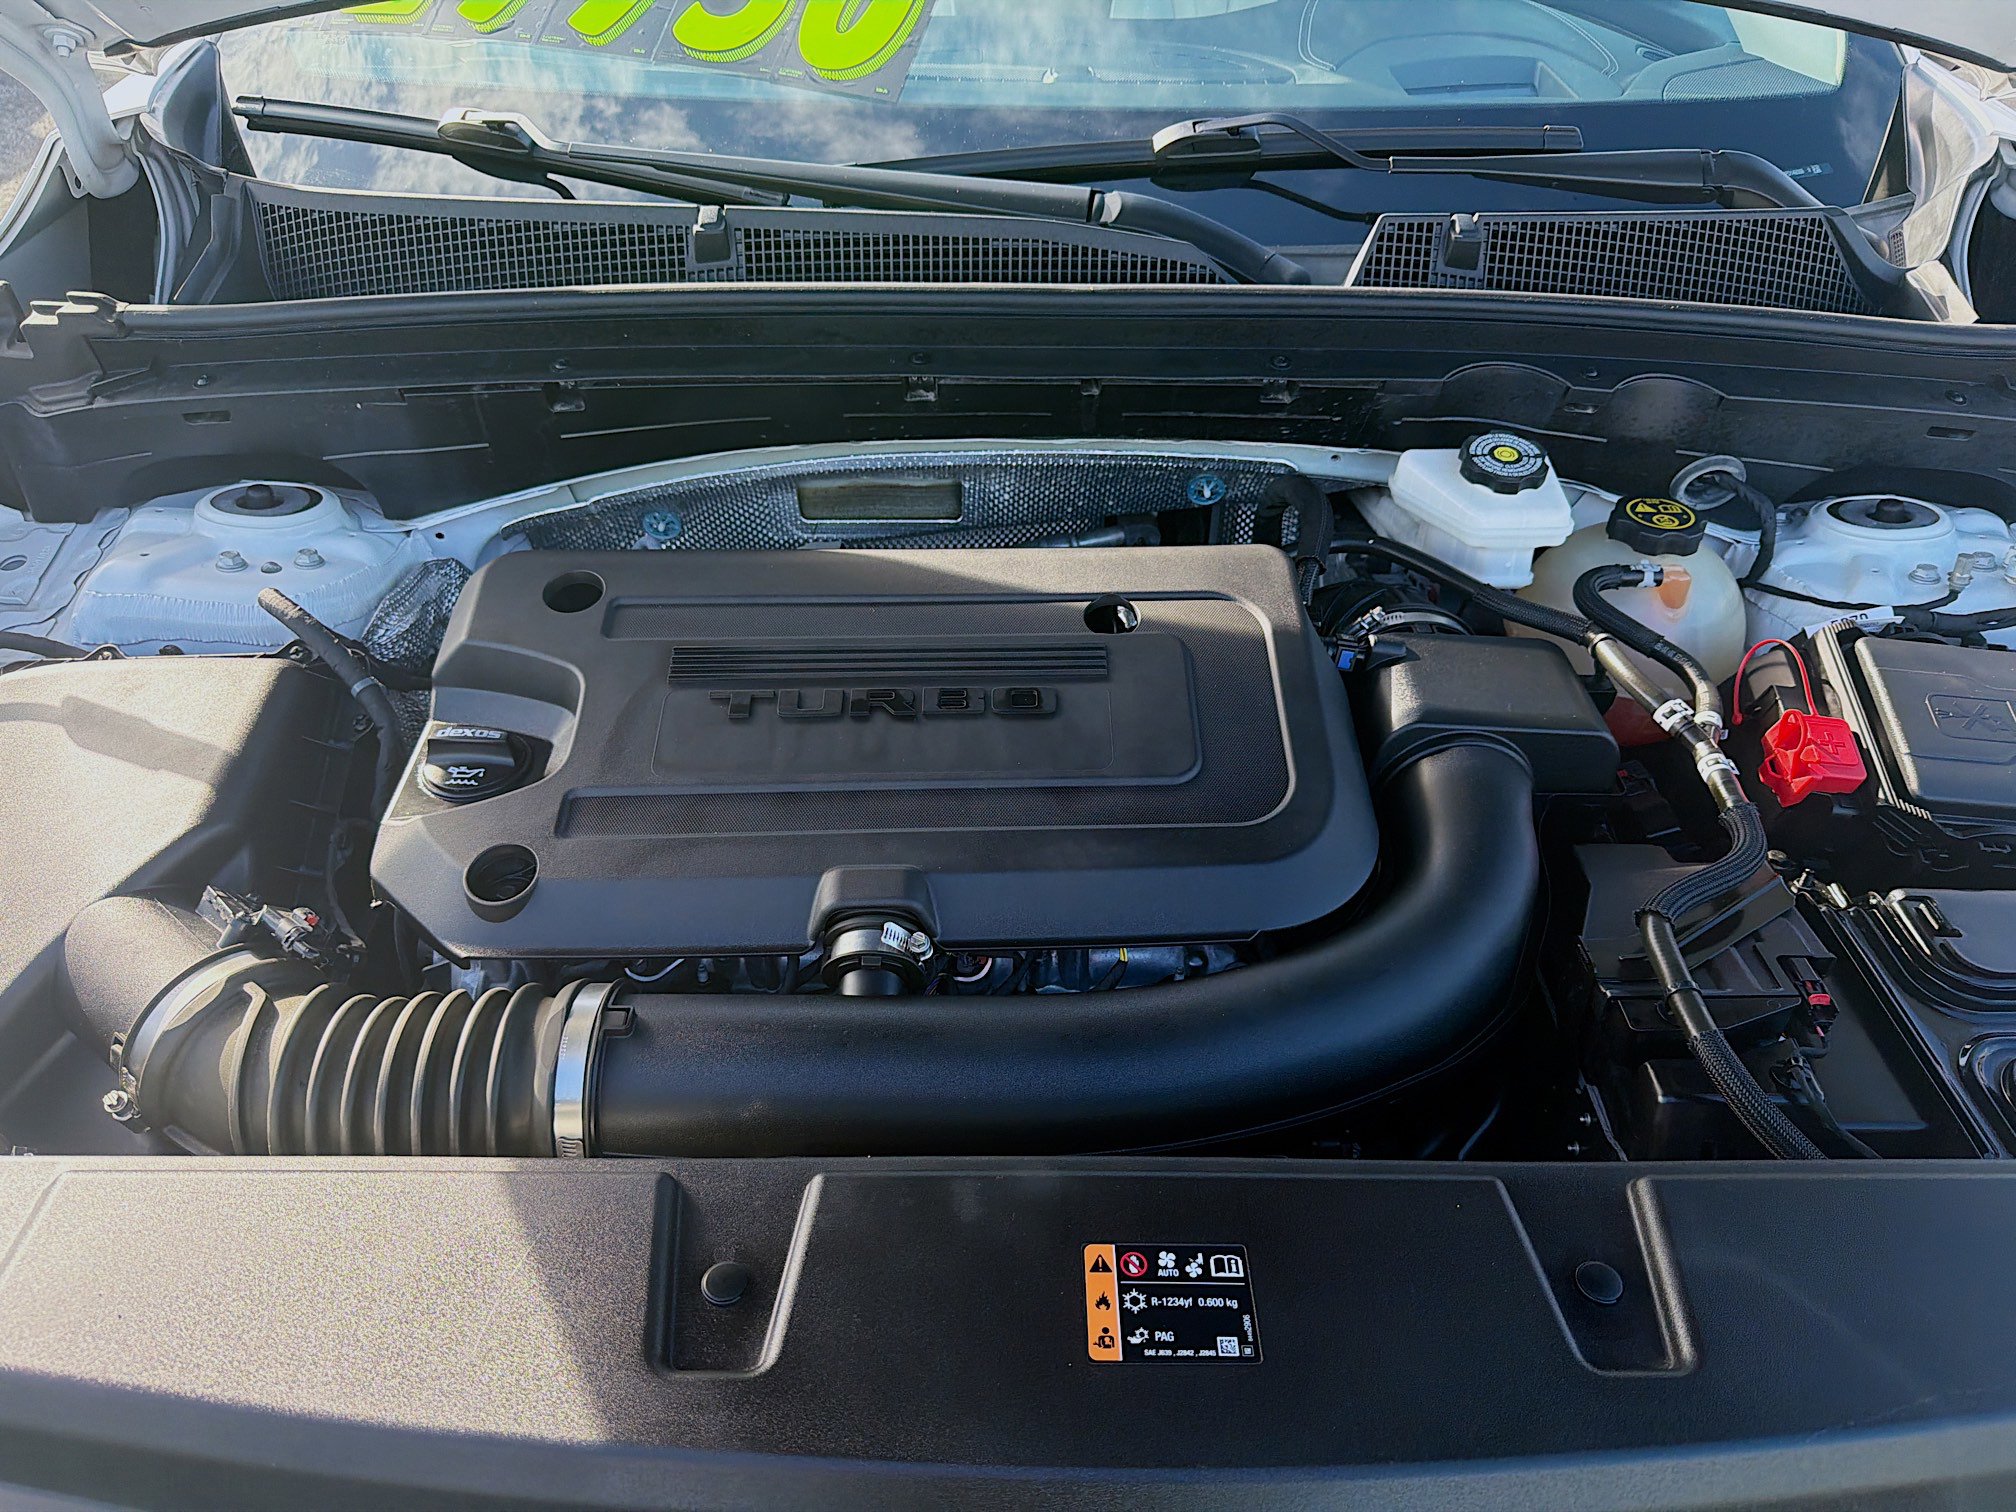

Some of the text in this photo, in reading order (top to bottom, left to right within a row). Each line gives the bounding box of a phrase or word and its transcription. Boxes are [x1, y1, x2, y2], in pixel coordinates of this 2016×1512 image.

[708, 686, 1059, 720] TURBO
[436, 726, 502, 739] dexos
[1157, 1268, 1180, 1277] AUTO
[1151, 1297, 1238, 1309] R-1234yf 0.600 kg
[1154, 1331, 1175, 1342] PAG
